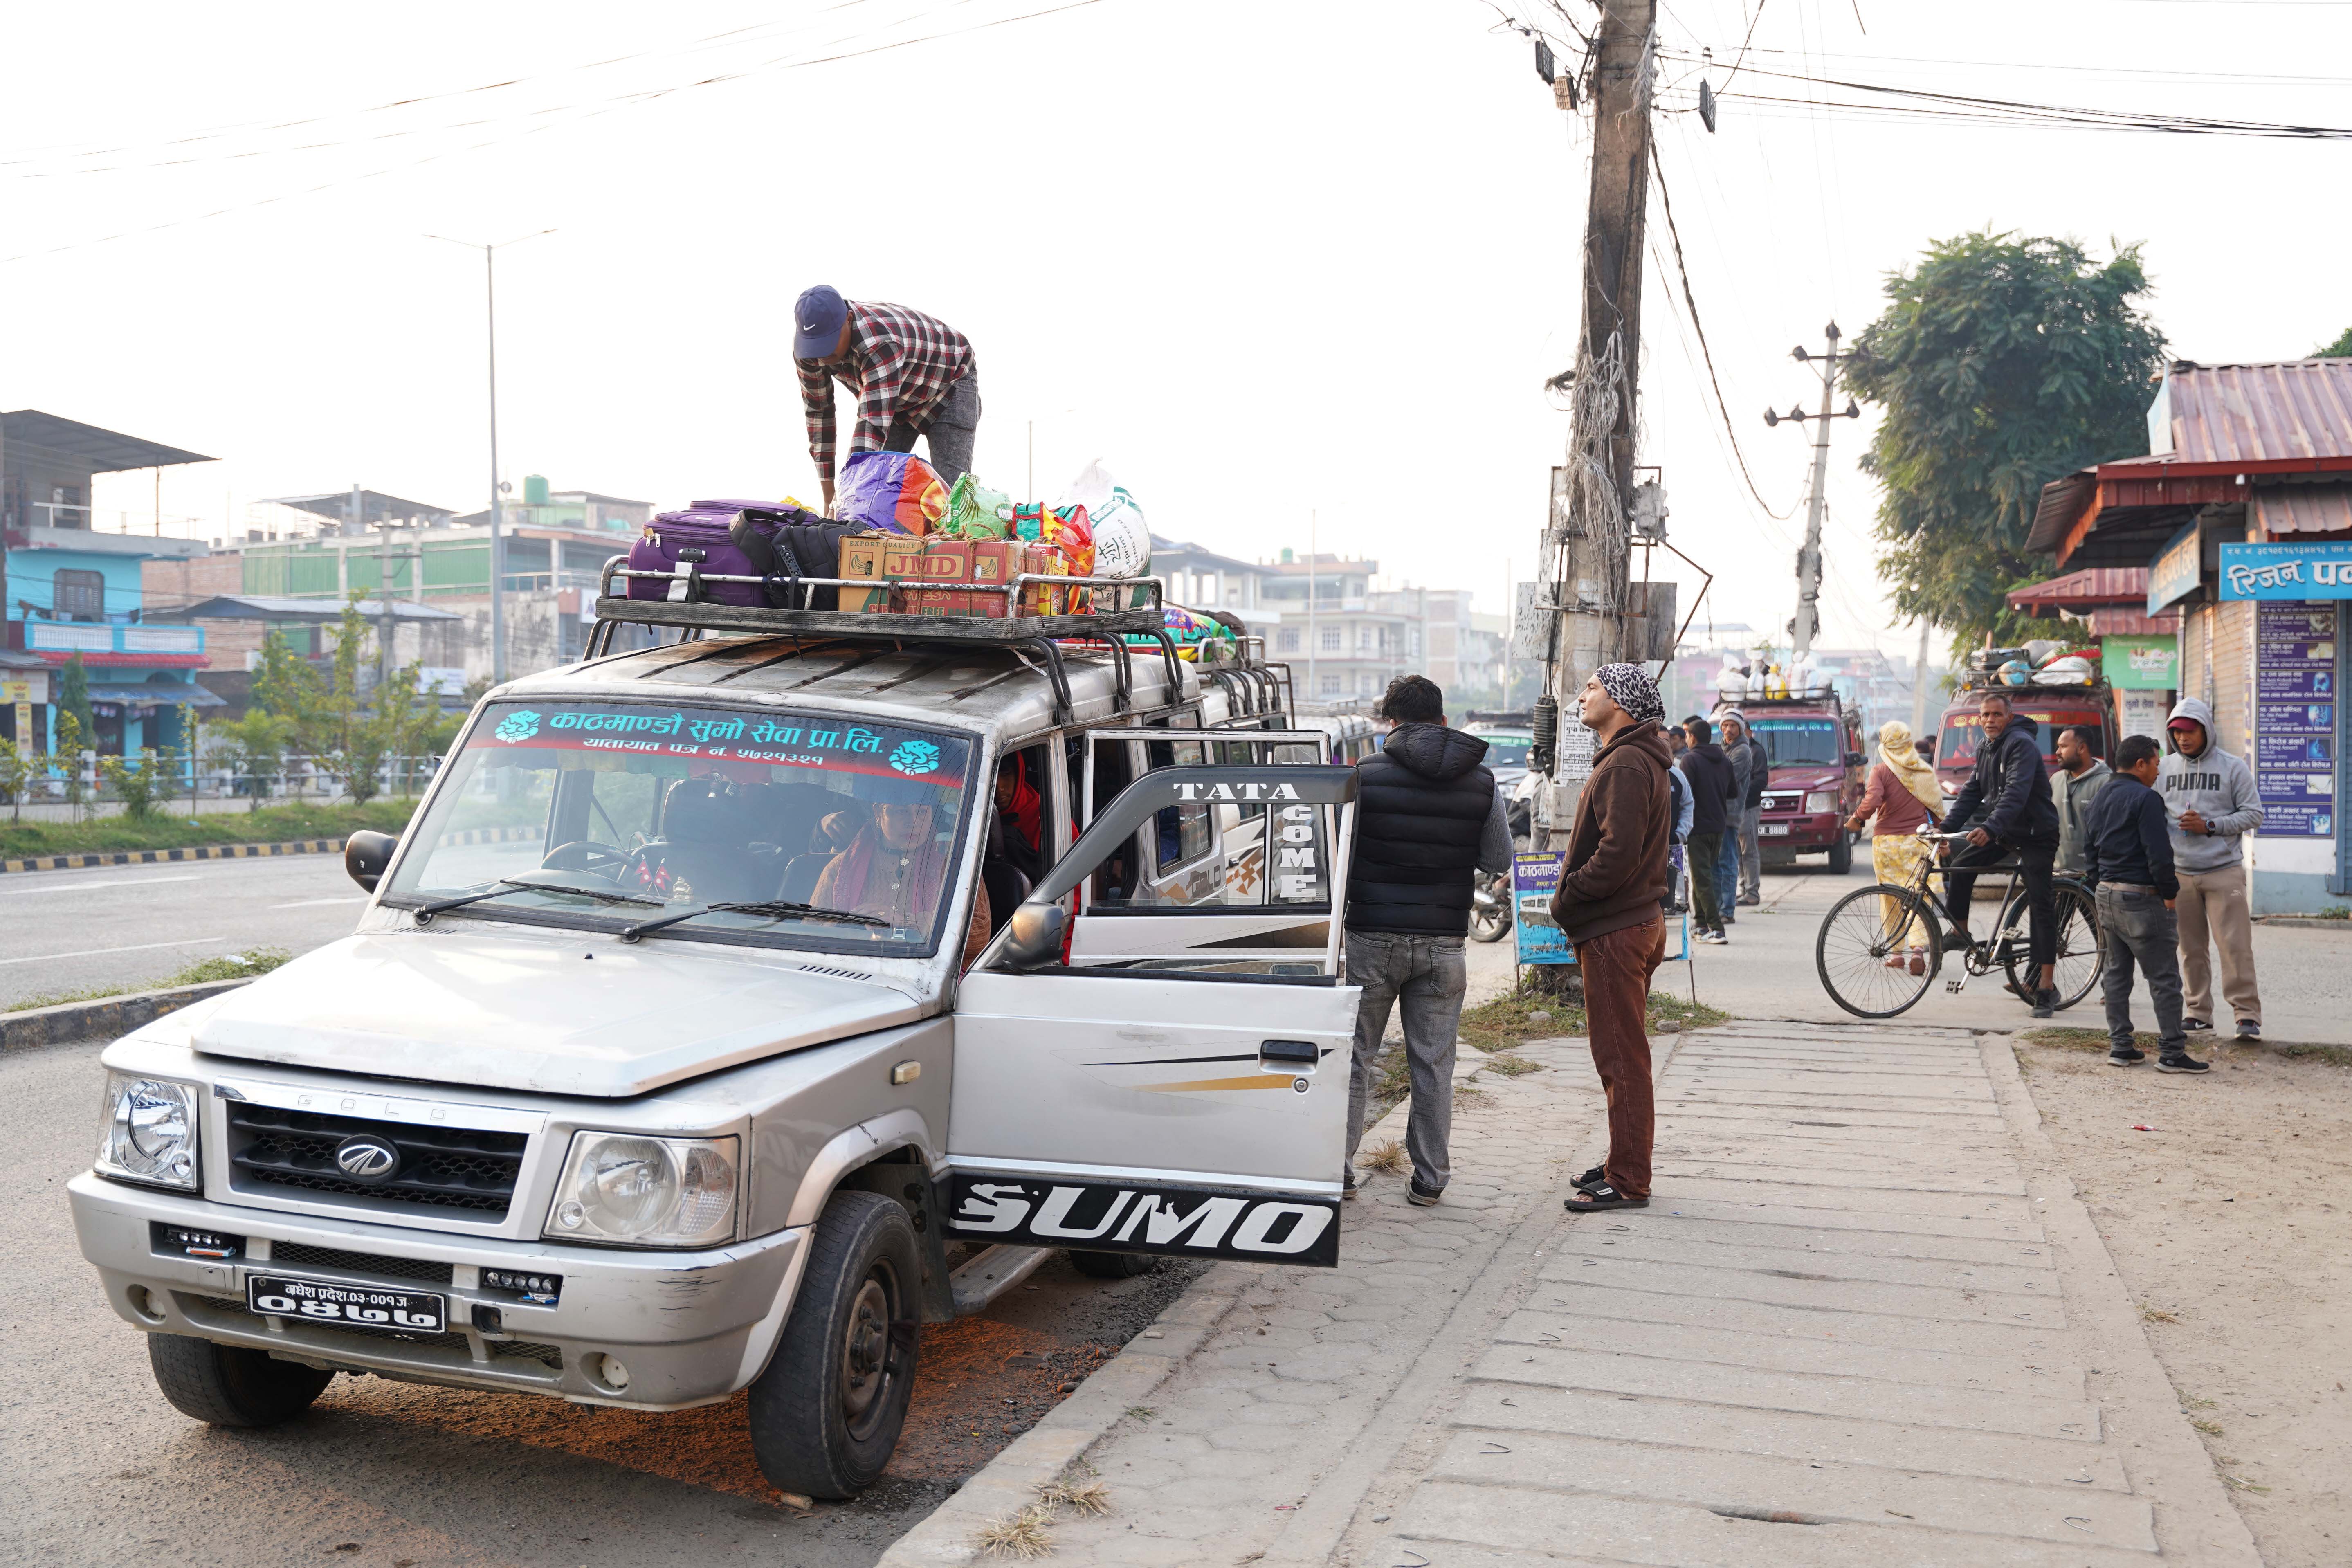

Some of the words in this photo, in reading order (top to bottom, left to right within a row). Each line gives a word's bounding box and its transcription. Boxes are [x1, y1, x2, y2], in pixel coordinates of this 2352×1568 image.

[890, 555, 957, 576] JMD
[2227, 559, 2305, 596] रिजन
[921, 607, 945, 615] FREE
[550, 712, 686, 735] काठमाण्डौ
[688, 718, 748, 743] सुमो
[751, 720, 805, 745] सेवा
[583, 737, 662, 752] यातायात
[669, 743, 702, 755] पत्र
[1173, 783, 1301, 800] TATA
[2166, 773, 2220, 792] PUMA
[1279, 762, 1316, 898] COME
[297, 1094, 447, 1121] GOLD
[947, 1183, 1334, 1254] SUMO
